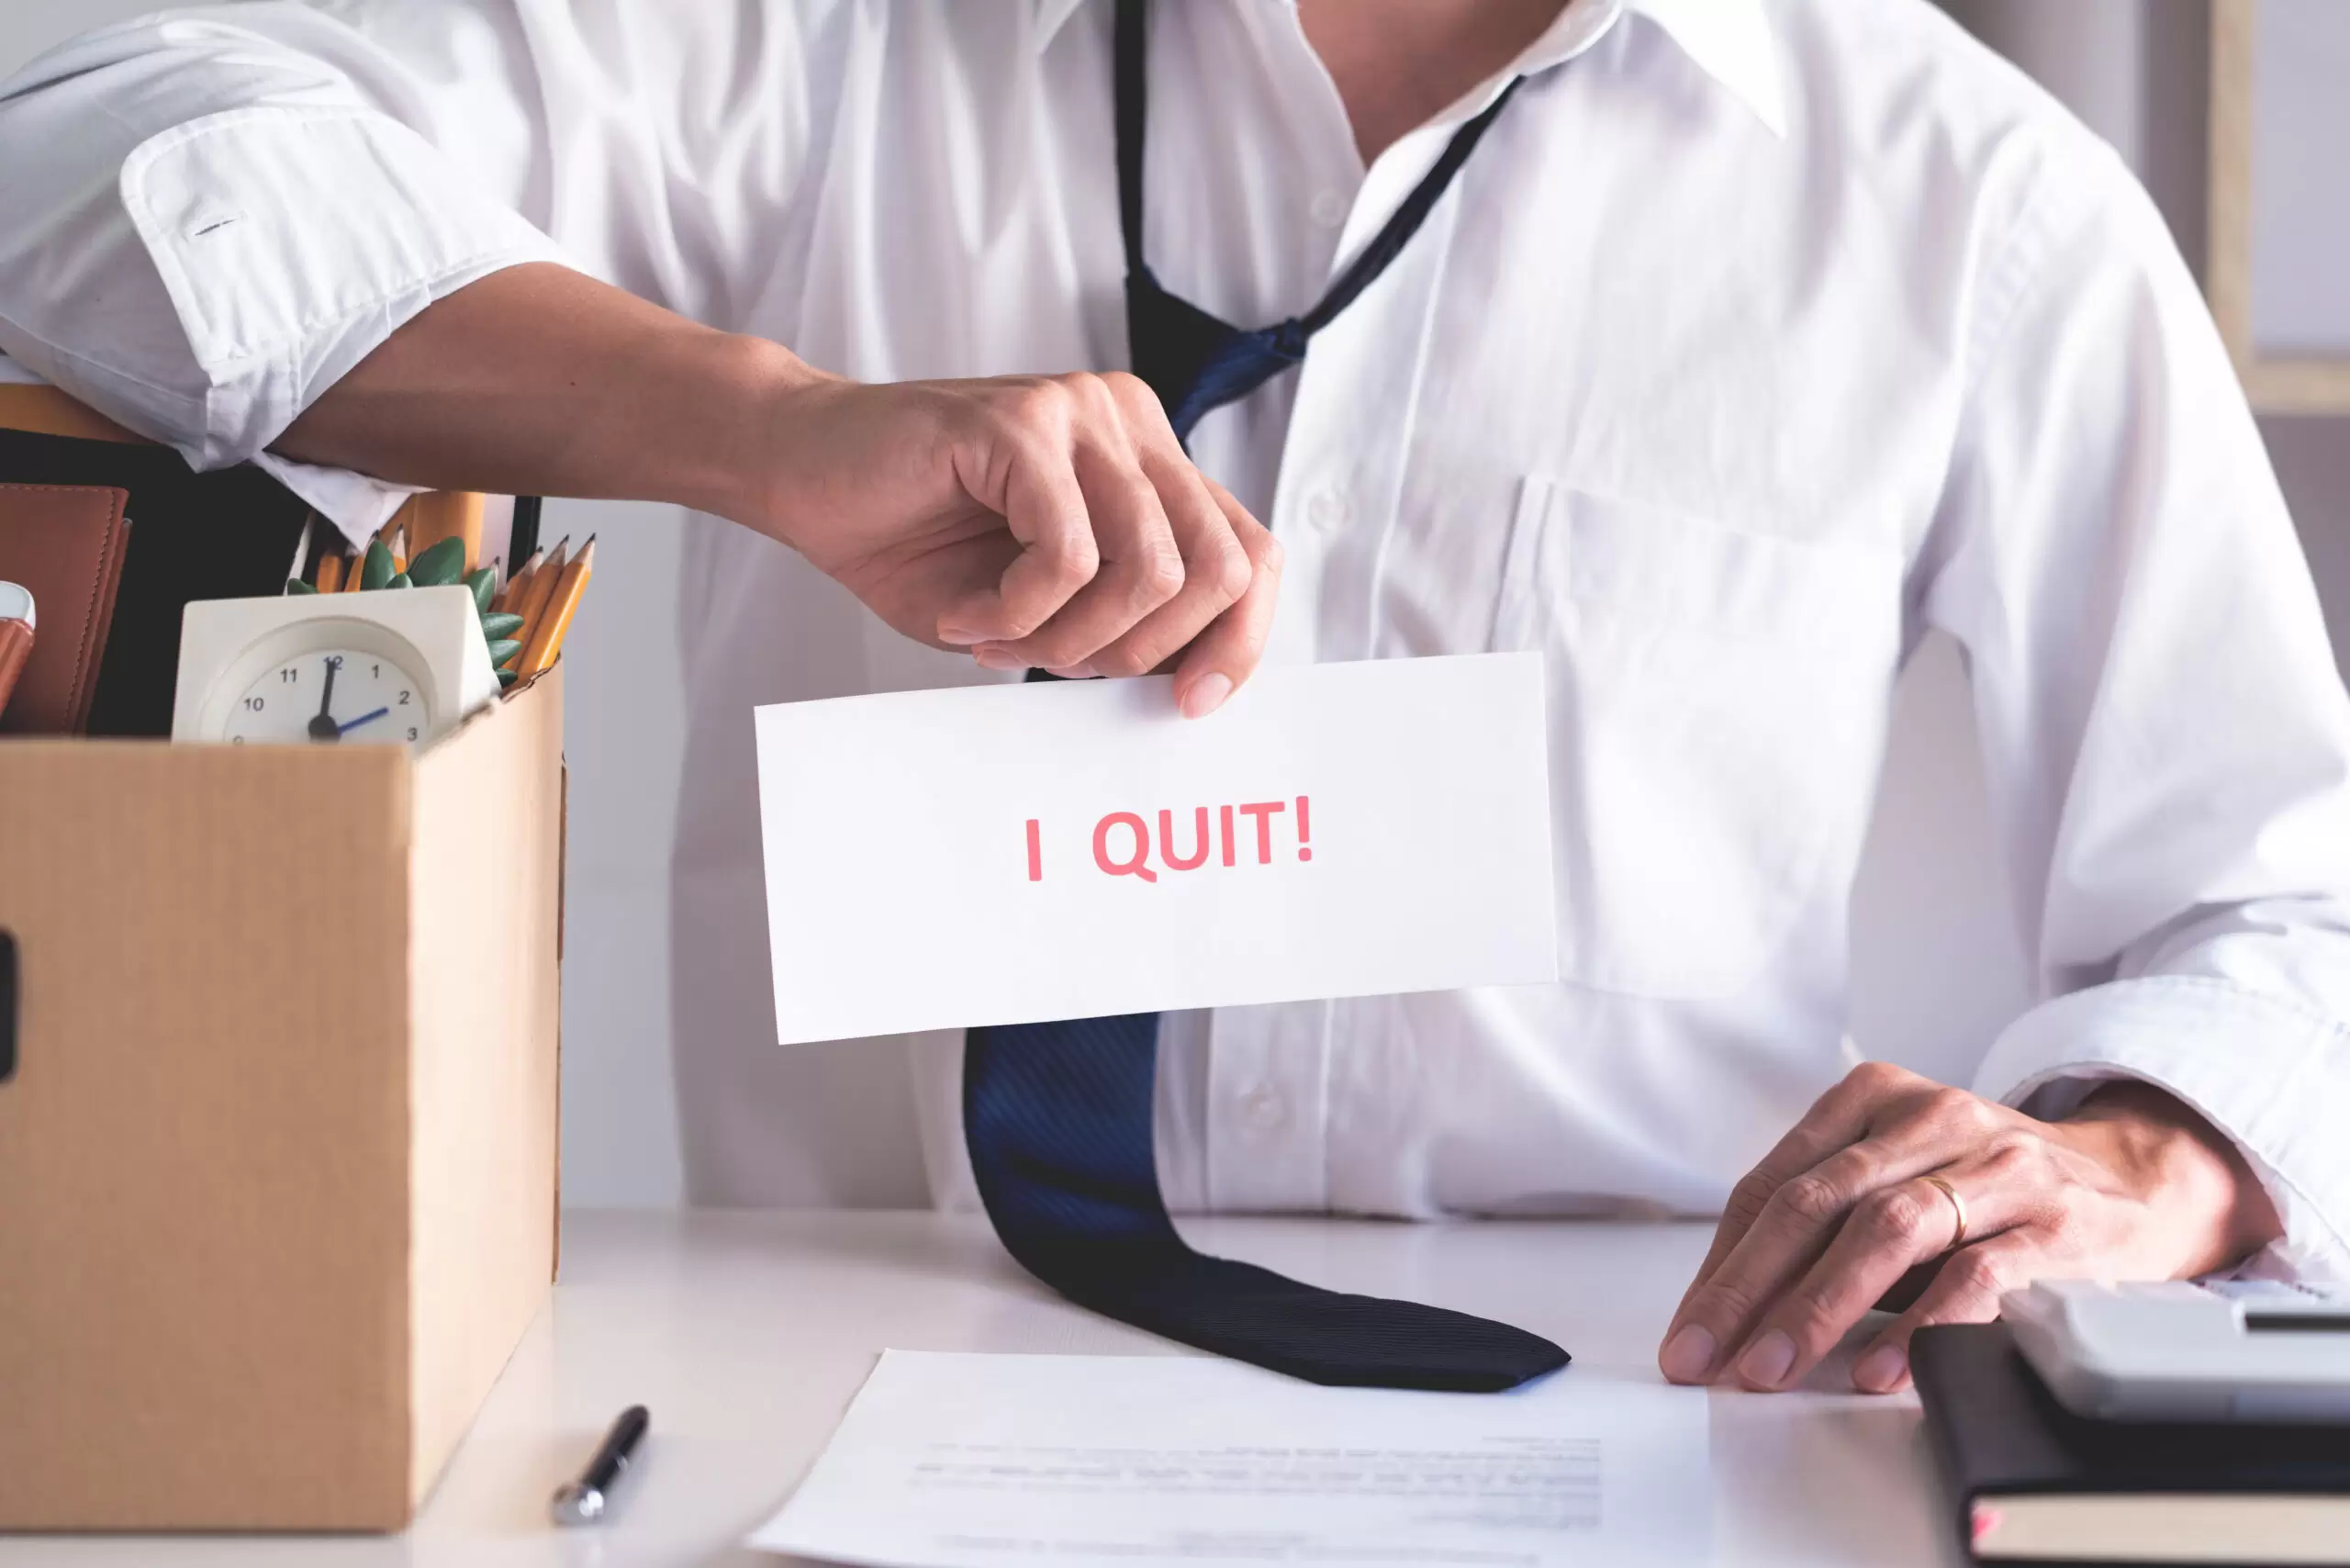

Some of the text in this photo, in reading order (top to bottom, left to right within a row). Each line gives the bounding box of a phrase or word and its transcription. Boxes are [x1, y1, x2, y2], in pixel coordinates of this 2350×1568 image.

[280, 668, 297, 683] 11
[372, 664, 379, 679] 1
[244, 697, 264, 711] 10
[398, 690, 410, 705] 2
[407, 727, 418, 742] 3
[1025, 796, 1314, 883] I QUIT!
